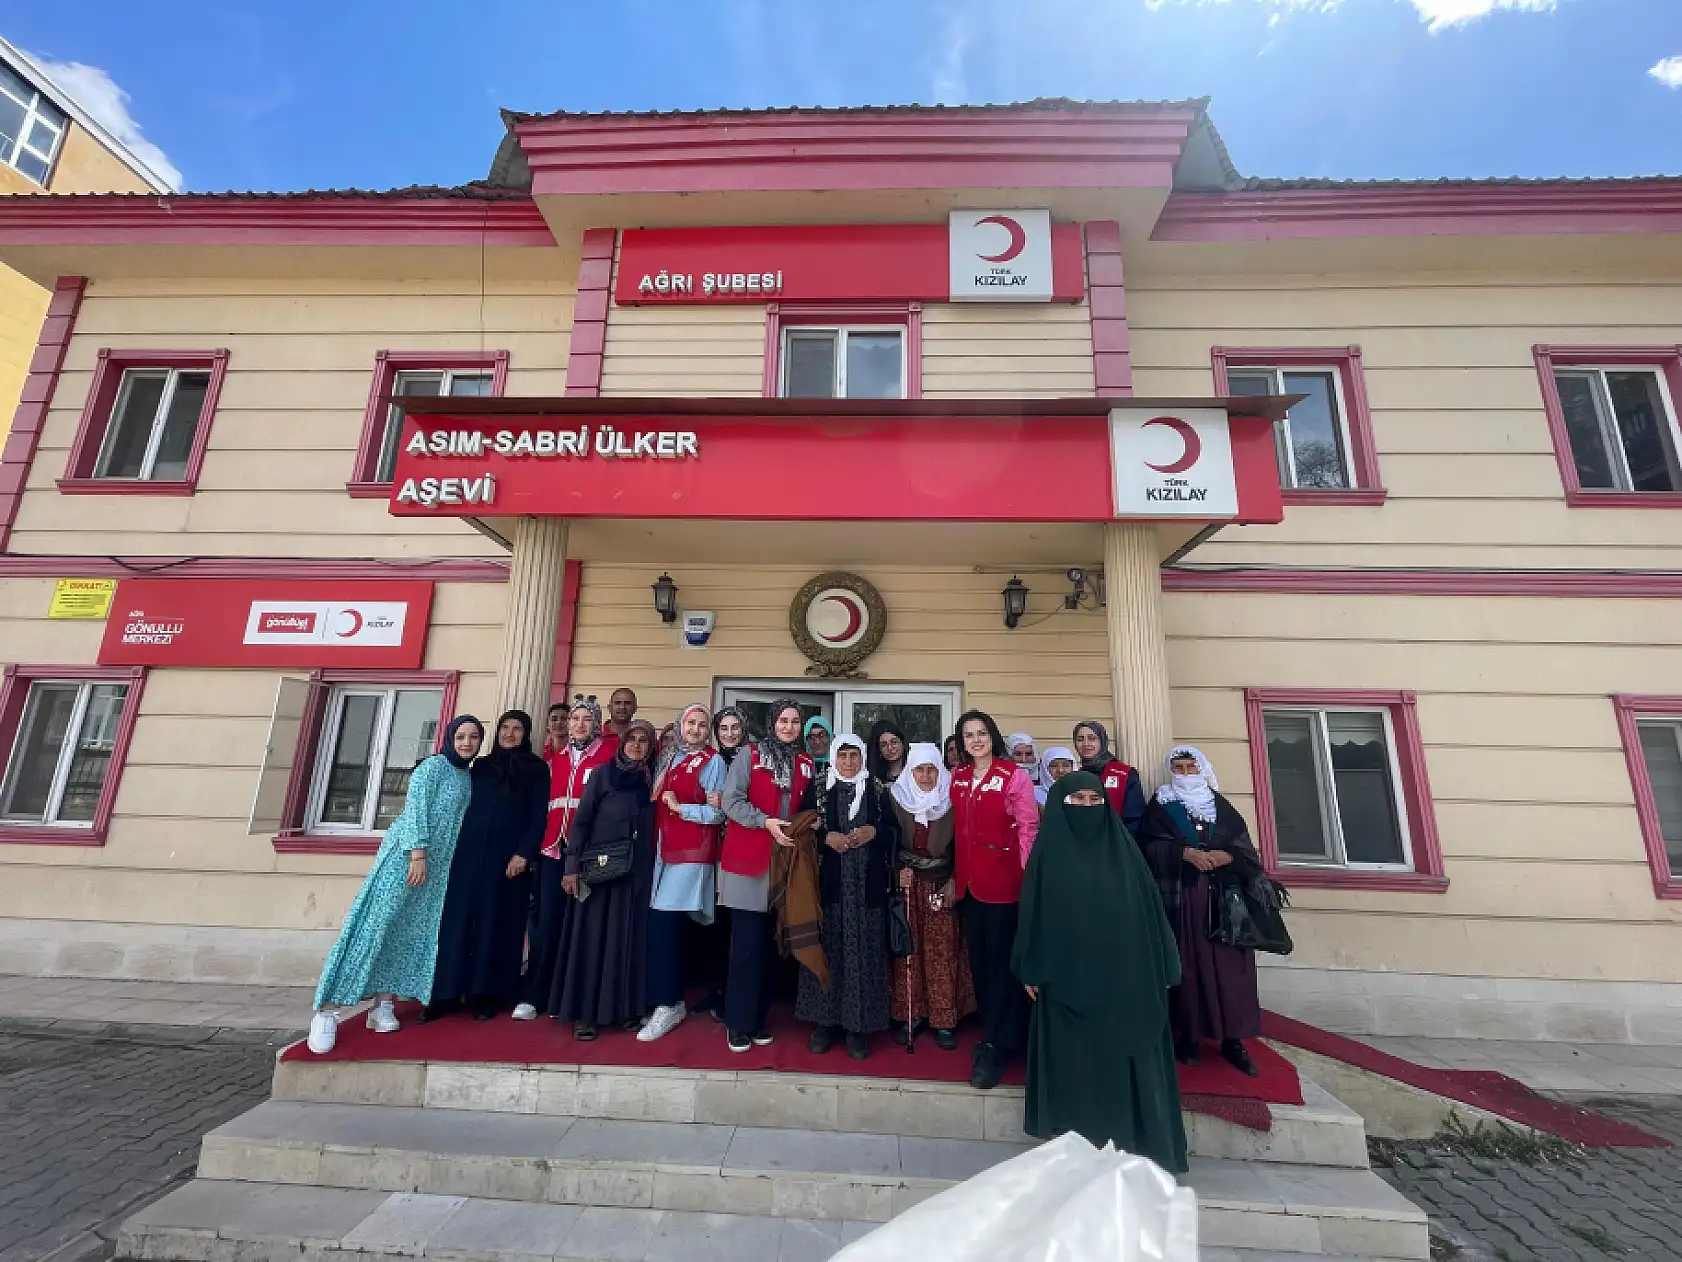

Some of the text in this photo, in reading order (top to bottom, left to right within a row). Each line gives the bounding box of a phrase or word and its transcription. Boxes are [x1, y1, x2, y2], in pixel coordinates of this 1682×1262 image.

[638, 269, 783, 295] AĞRI ŞUBESİ
[974, 275, 1027, 286] KIZILAY
[406, 424, 698, 458] ASIM-SABRİ ÜLKER
[396, 472, 496, 508] AŞEVİ
[1146, 488, 1208, 501] KIZILAY
